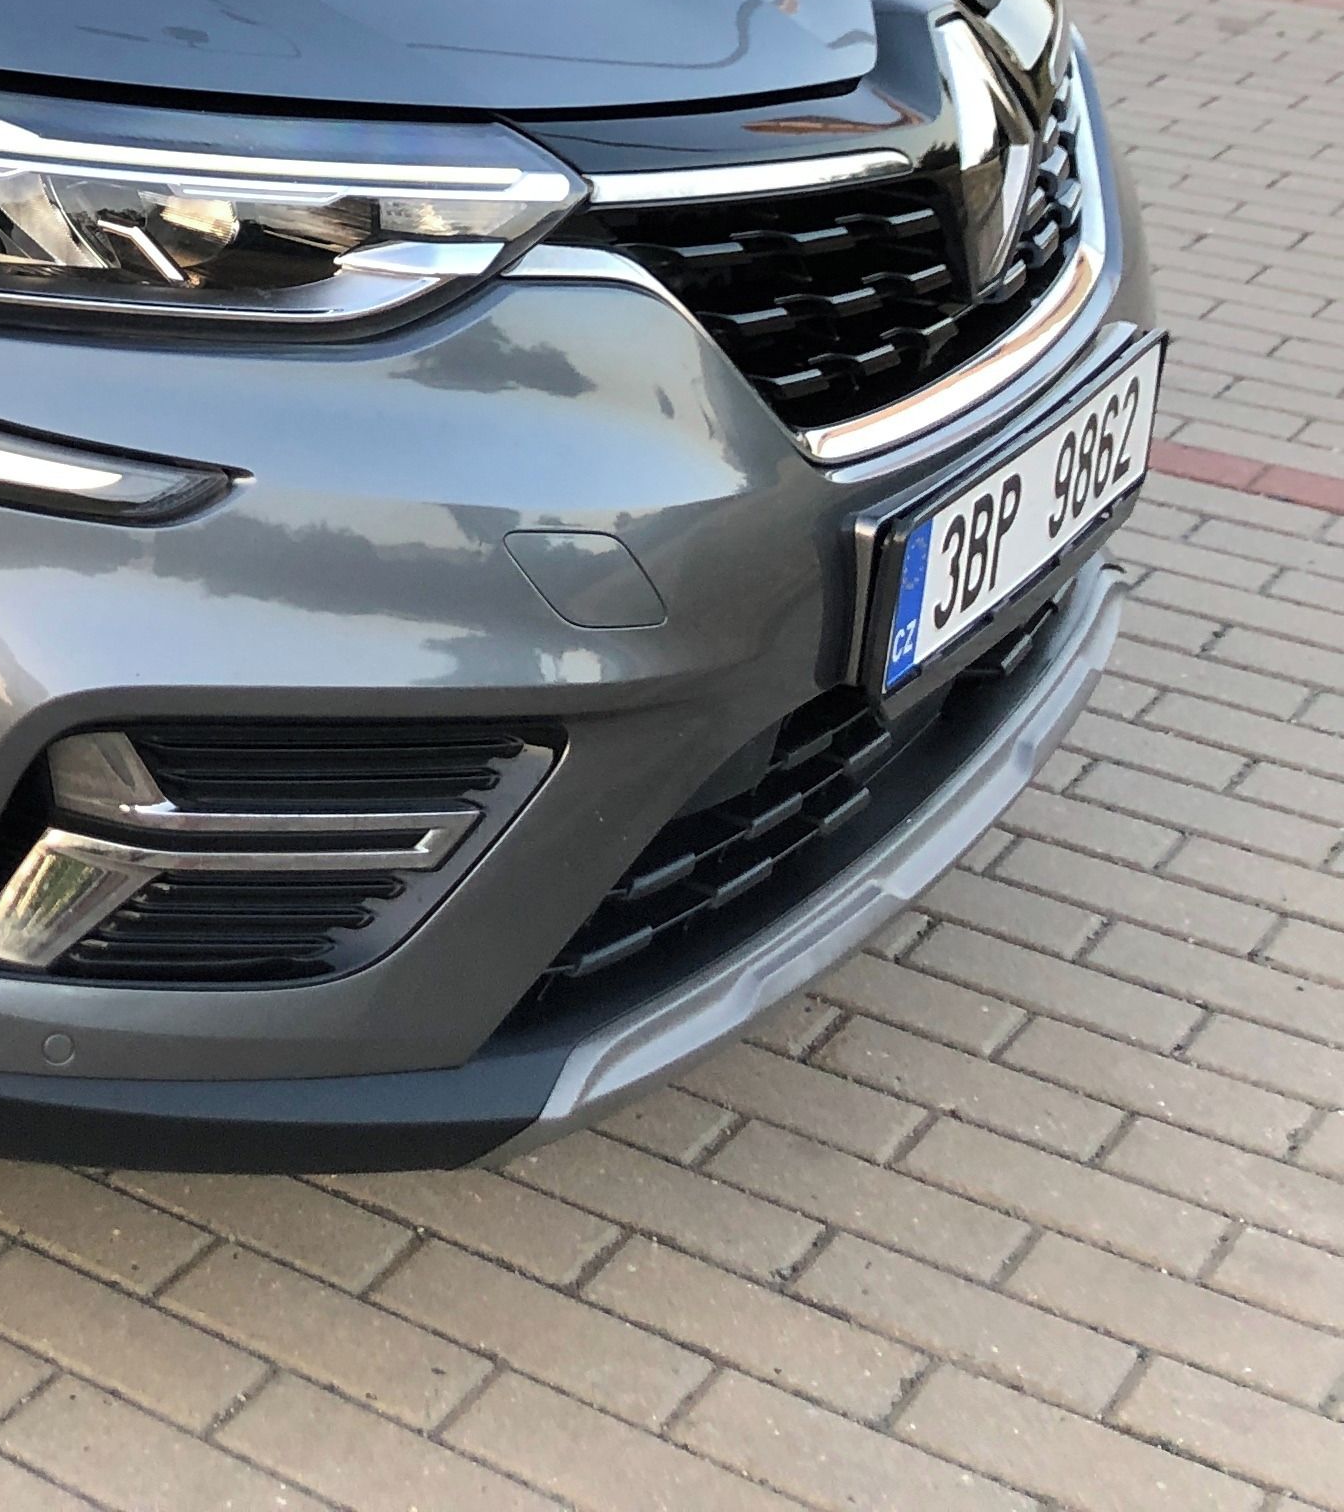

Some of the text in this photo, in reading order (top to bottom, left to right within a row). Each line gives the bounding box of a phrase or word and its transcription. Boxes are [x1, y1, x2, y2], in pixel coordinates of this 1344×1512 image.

[933, 377, 1140, 630] 3BP 9862
[892, 618, 917, 663] CZ
